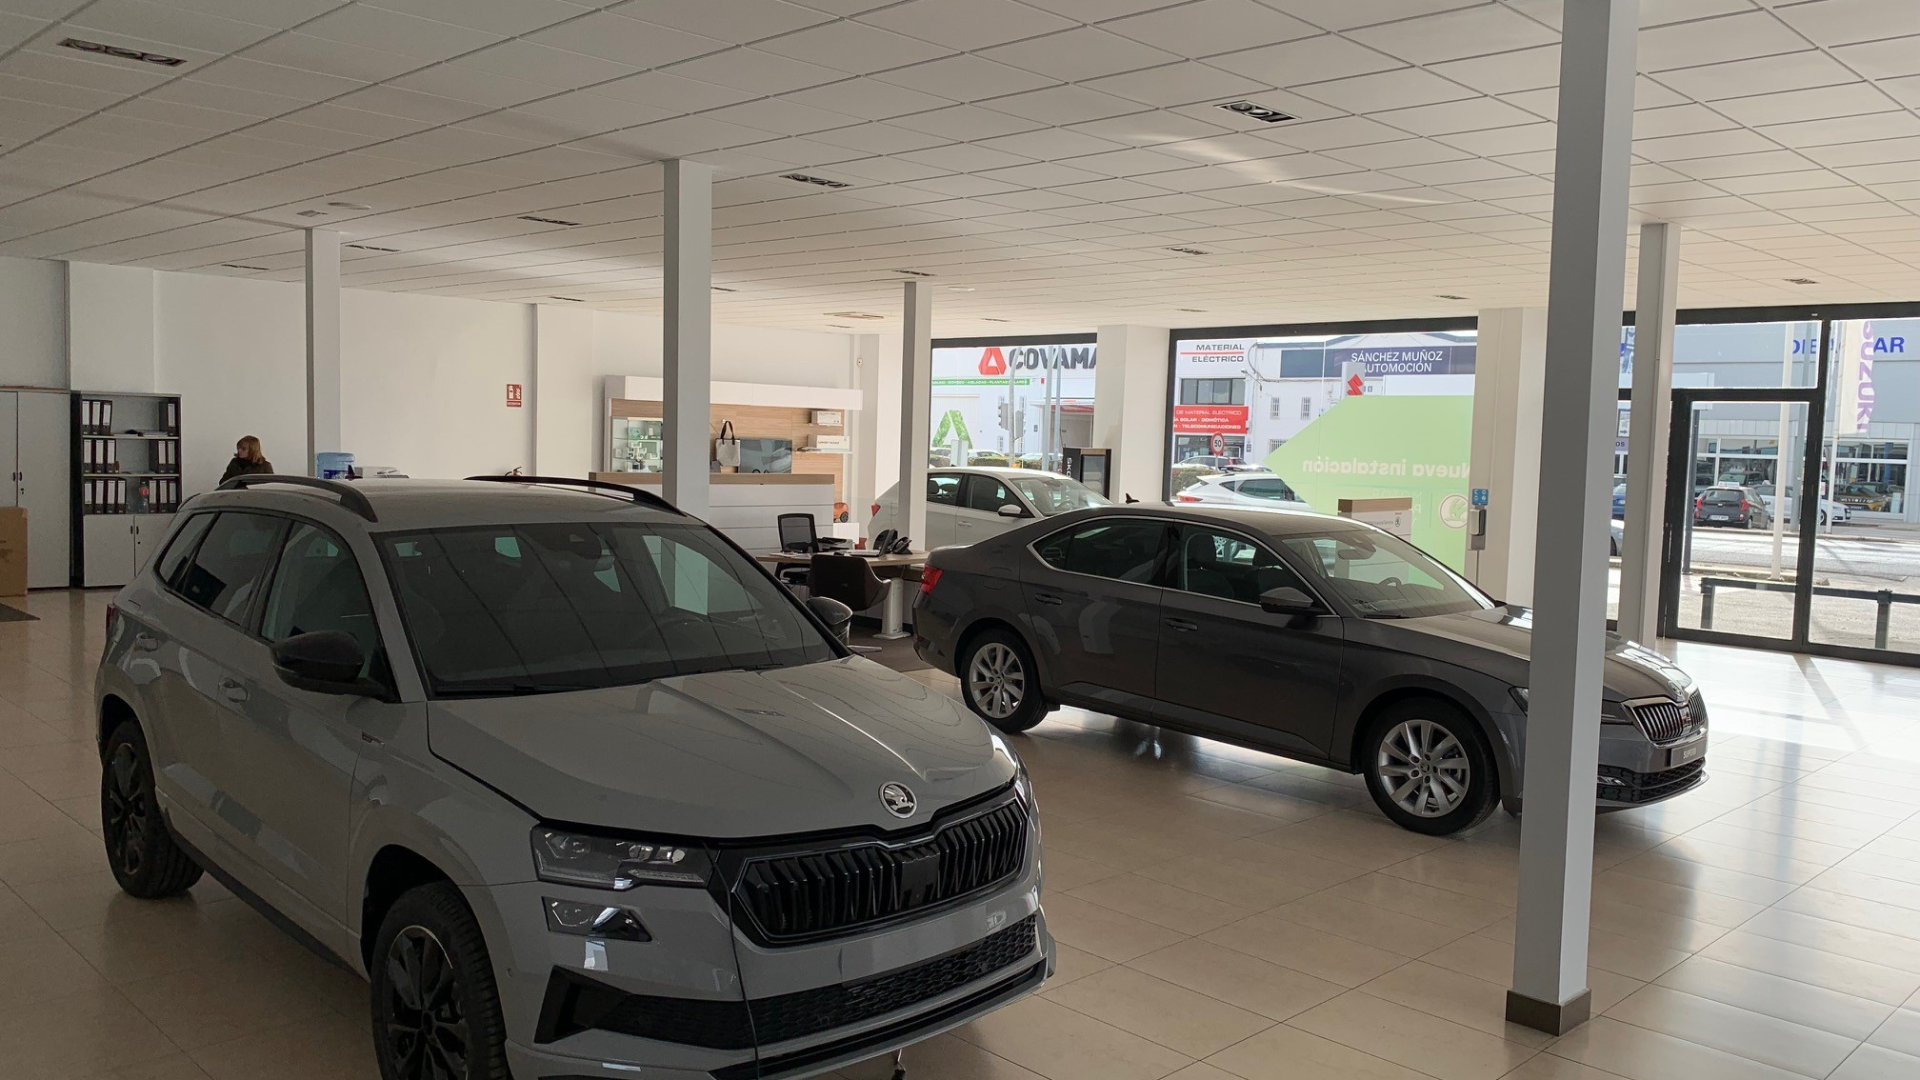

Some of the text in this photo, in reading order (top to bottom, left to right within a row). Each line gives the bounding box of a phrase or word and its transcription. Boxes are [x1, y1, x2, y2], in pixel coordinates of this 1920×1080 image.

[1192, 354, 1244, 363] ELÉCTRICO
[1351, 349, 1443, 362] SÁNCHEZ MUÑOZ
[1856, 321, 1874, 430] SUZUKI
[1214, 439, 1222, 447] 50
